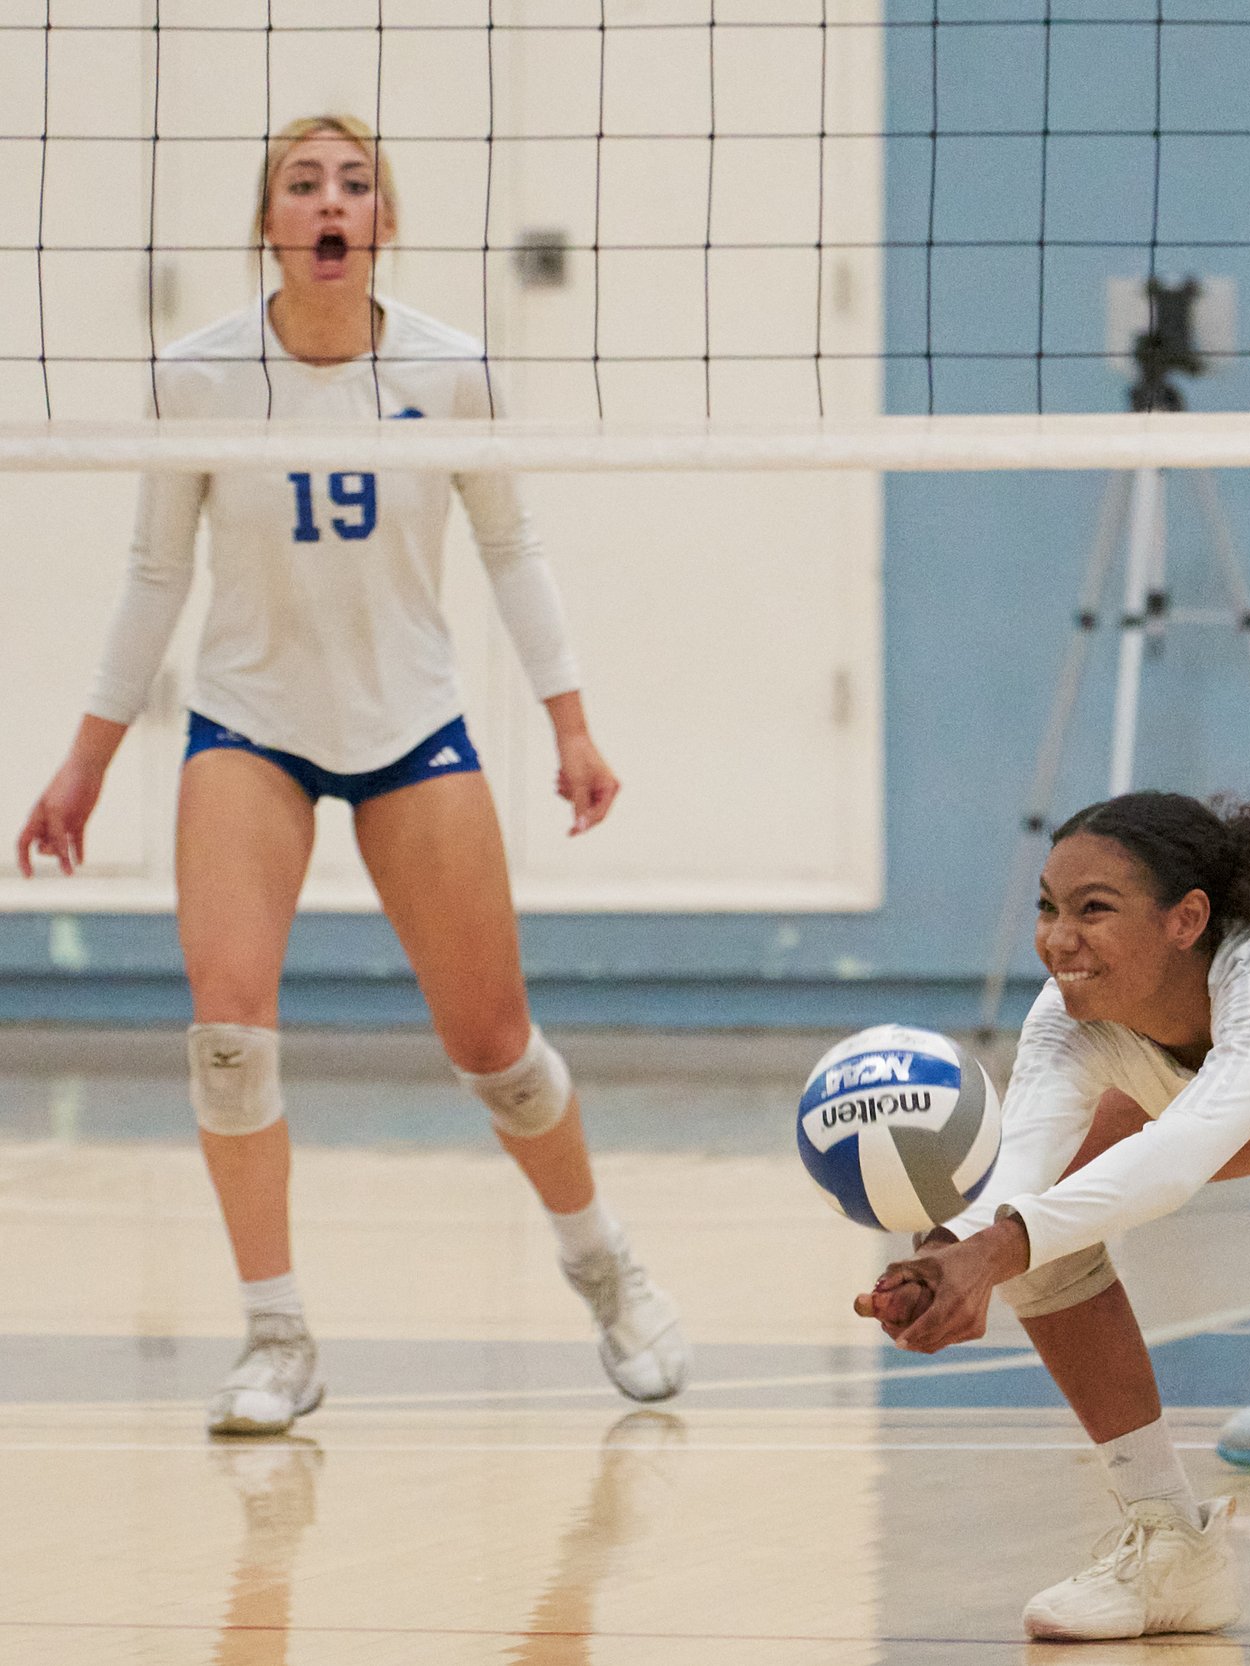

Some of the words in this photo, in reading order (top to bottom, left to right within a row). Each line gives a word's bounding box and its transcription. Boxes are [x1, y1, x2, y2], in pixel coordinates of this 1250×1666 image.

[288, 472, 377, 541] 19
[826, 1053, 914, 1096] NCAA
[822, 1091, 931, 1128] molten
